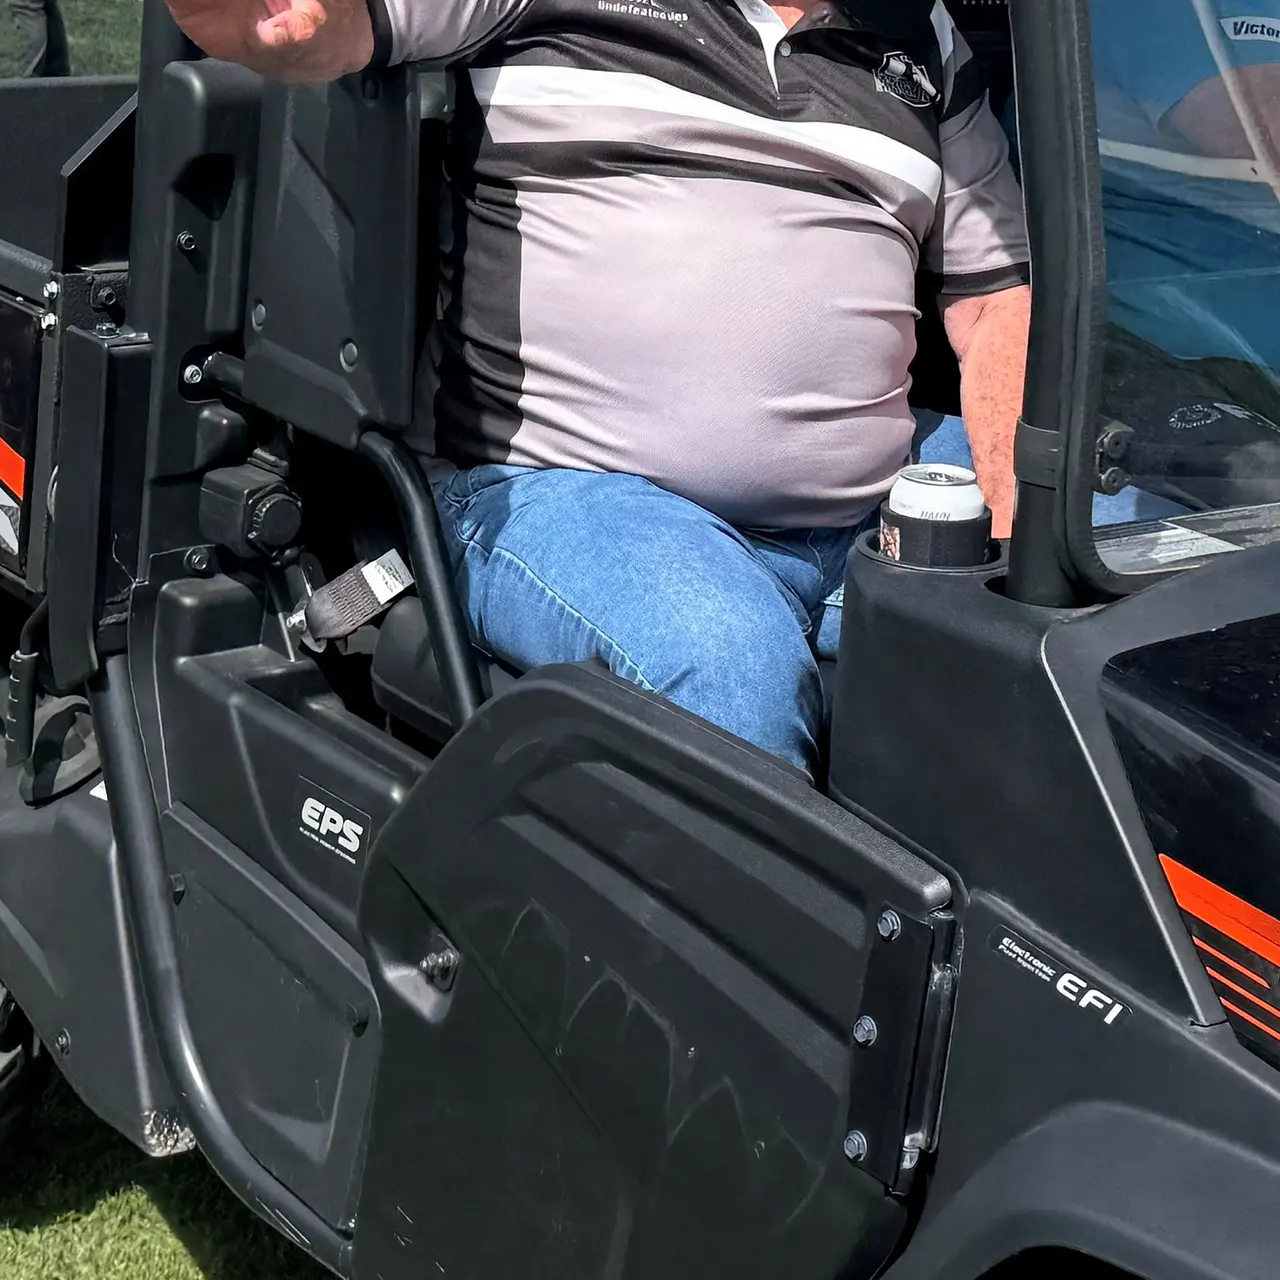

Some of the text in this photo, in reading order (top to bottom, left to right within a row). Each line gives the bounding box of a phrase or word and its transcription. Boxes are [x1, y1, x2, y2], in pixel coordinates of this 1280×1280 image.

[301, 797, 364, 852] EPS
[1001, 936, 1057, 977] Electronic
[1056, 972, 1124, 1025] EFI
